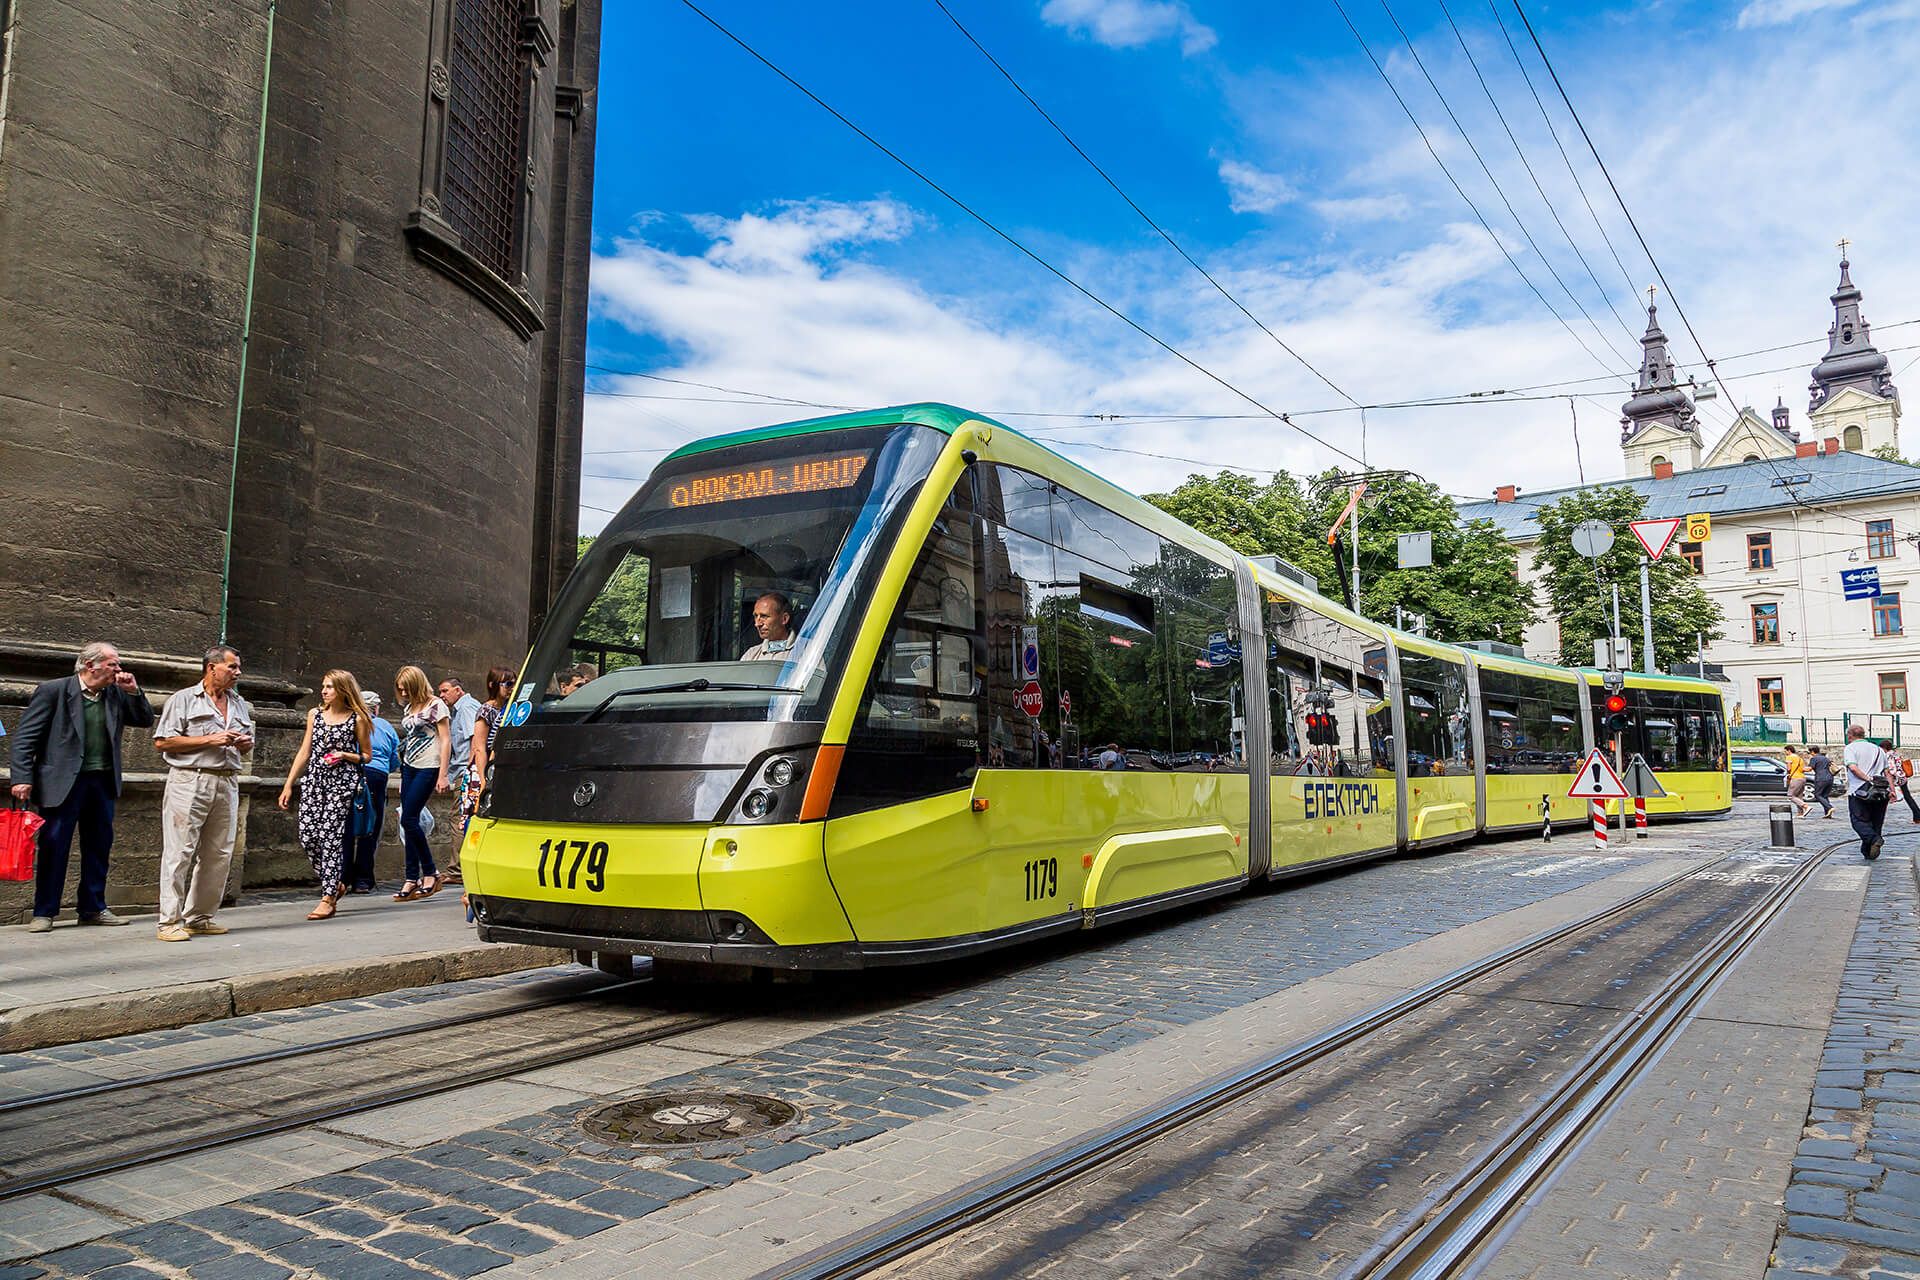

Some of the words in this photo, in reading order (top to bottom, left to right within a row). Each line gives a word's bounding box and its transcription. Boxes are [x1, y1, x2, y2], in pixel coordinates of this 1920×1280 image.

[692, 469, 774, 498] ВОКЗАЛ
[793, 456, 867, 484] ЦЕНТР
[1304, 783, 1379, 819] ЕЛЕКТРОН
[538, 839, 609, 892] 1179
[1024, 857, 1057, 901] 1179
